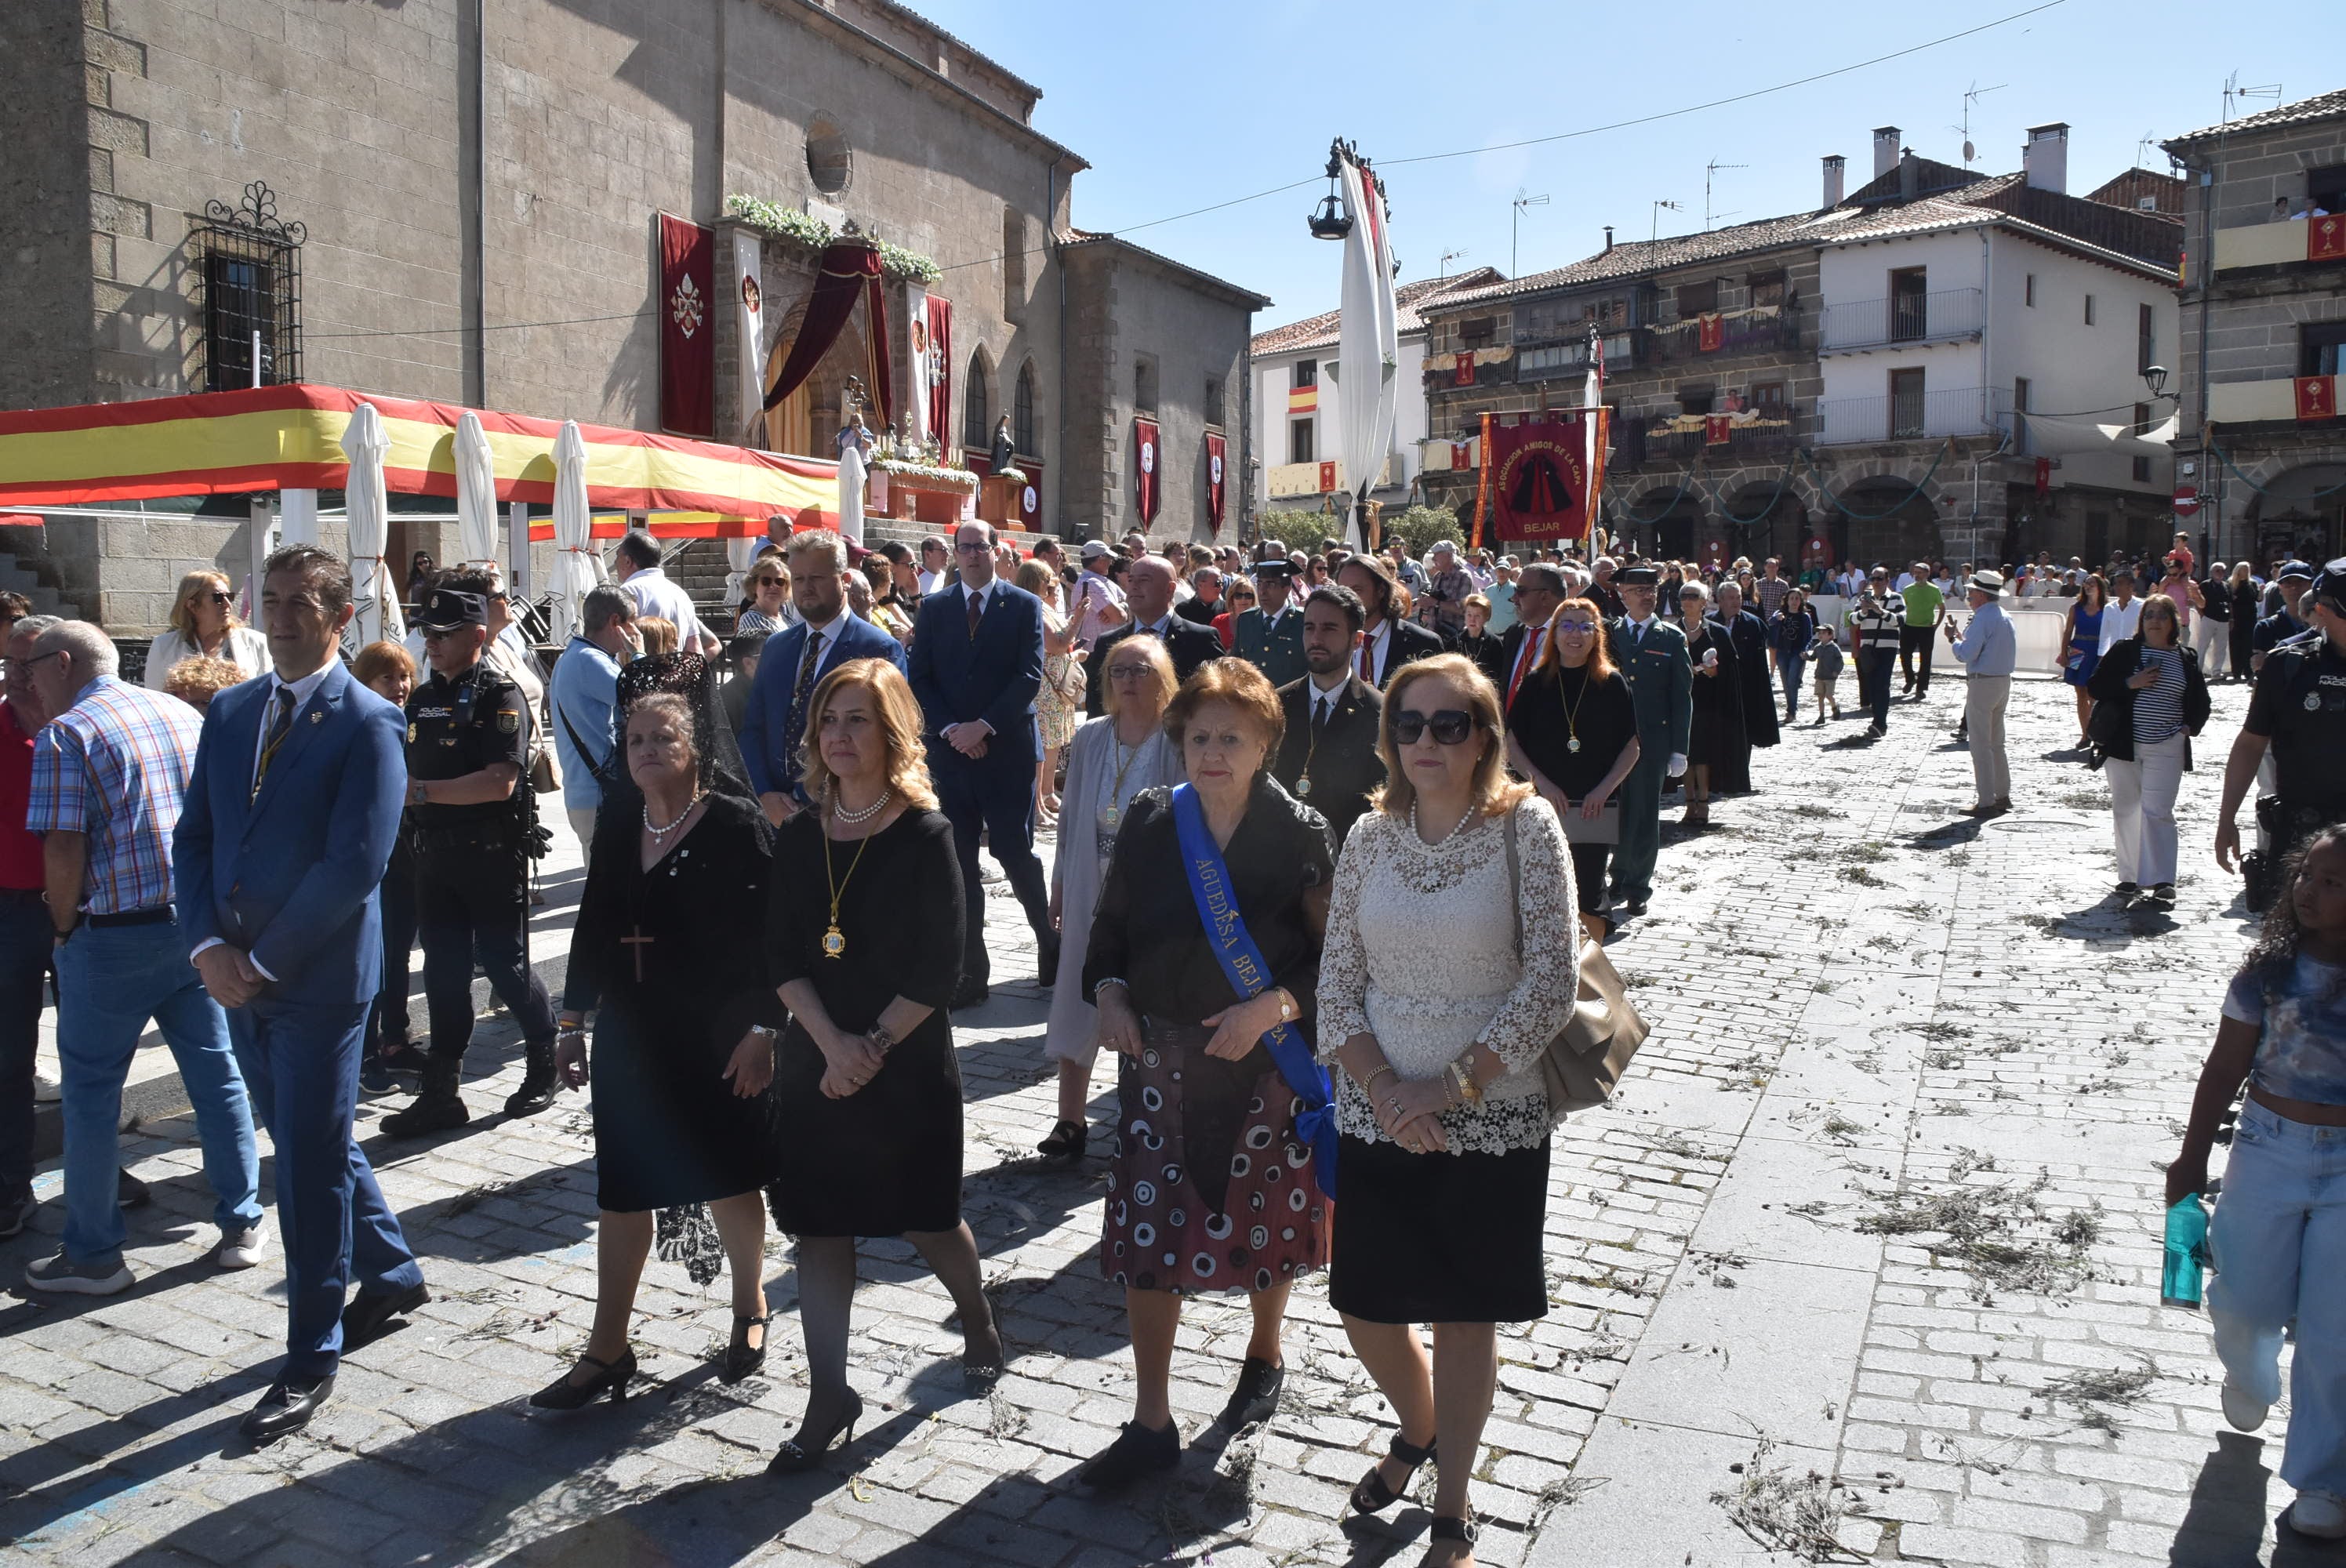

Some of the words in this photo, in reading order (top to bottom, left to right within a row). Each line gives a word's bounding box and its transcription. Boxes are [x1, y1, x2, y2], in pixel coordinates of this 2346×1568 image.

[1498, 448, 1523, 492] ASOCIACION
[1524, 441, 1554, 452] AMIGOS
[1554, 445, 1567, 456] DE
[1564, 453, 1574, 465] LA
[1571, 465, 1582, 486] CAPA
[1523, 521, 1560, 534] BEJAR
[1232, 953, 1266, 998] BEJA
[1270, 1024, 1288, 1047] 24
